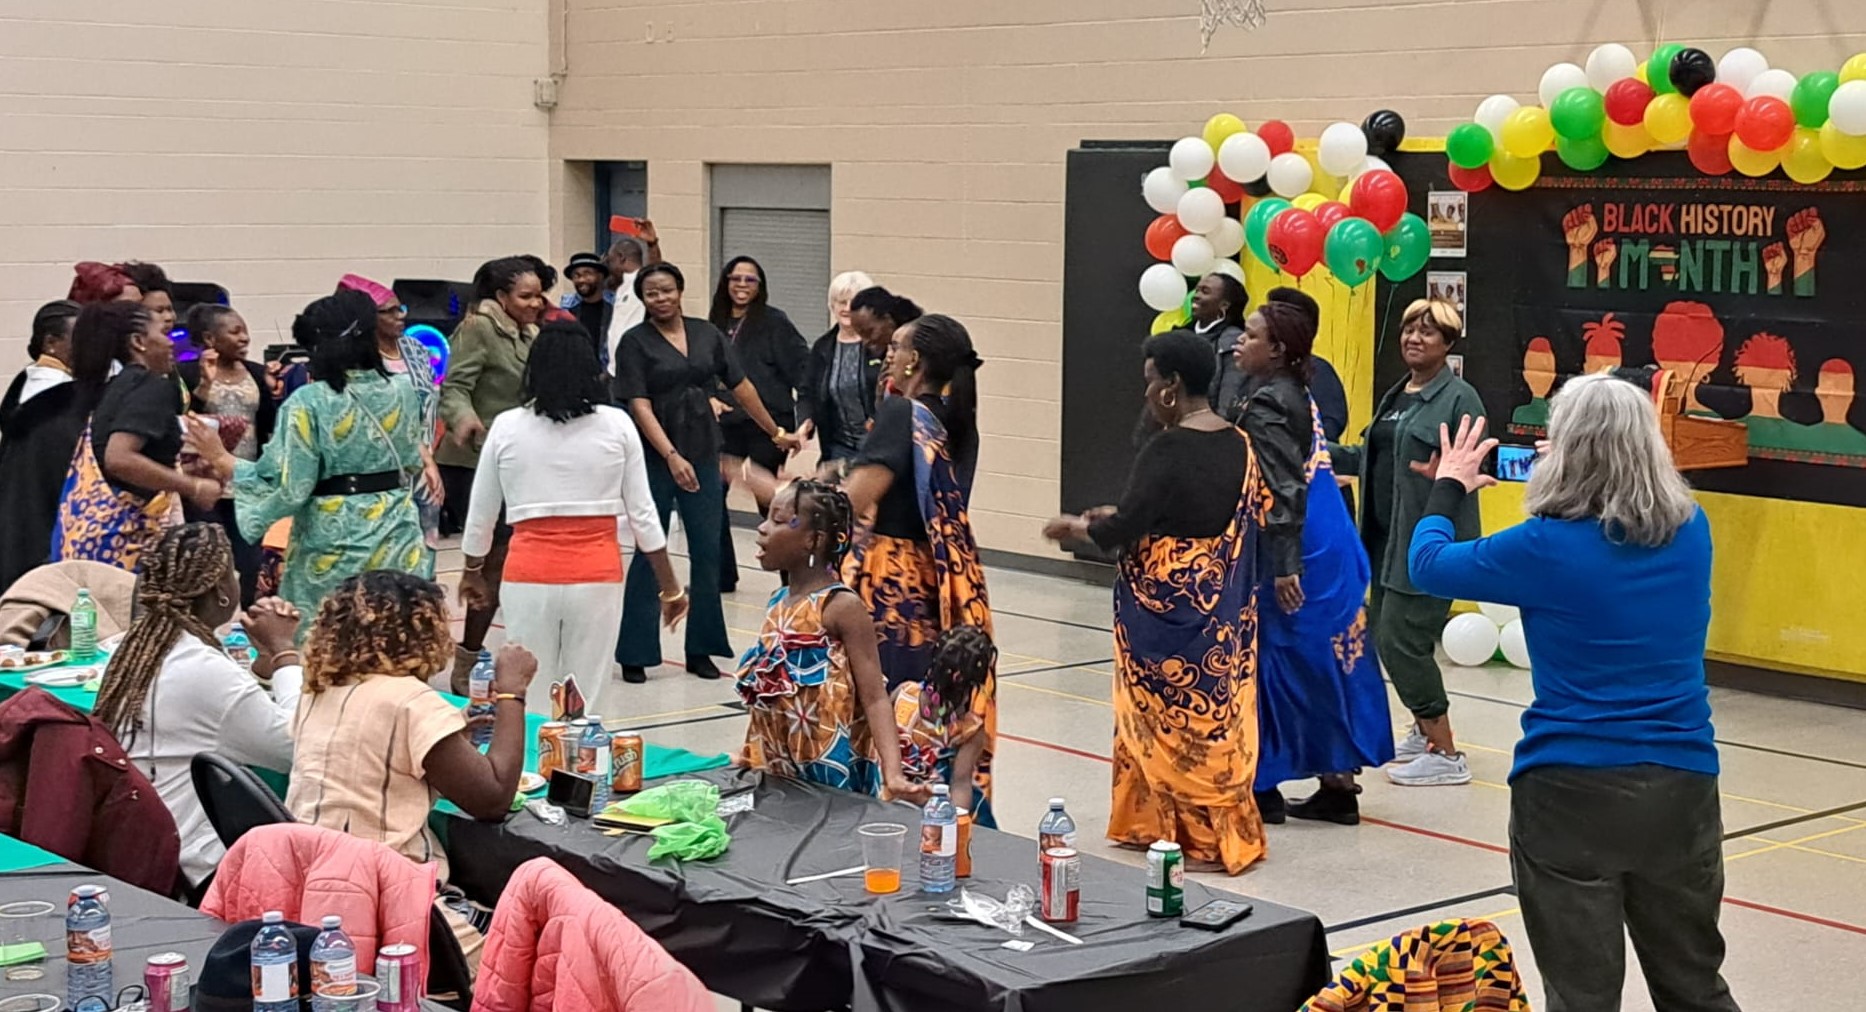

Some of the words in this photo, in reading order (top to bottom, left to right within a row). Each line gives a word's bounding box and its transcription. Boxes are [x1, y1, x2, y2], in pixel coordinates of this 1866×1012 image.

[1603, 203, 1675, 234] BLACK
[1680, 203, 1776, 237] HISTORY
[1619, 238, 1758, 294] MNTH
[612, 748, 638, 775] rush
